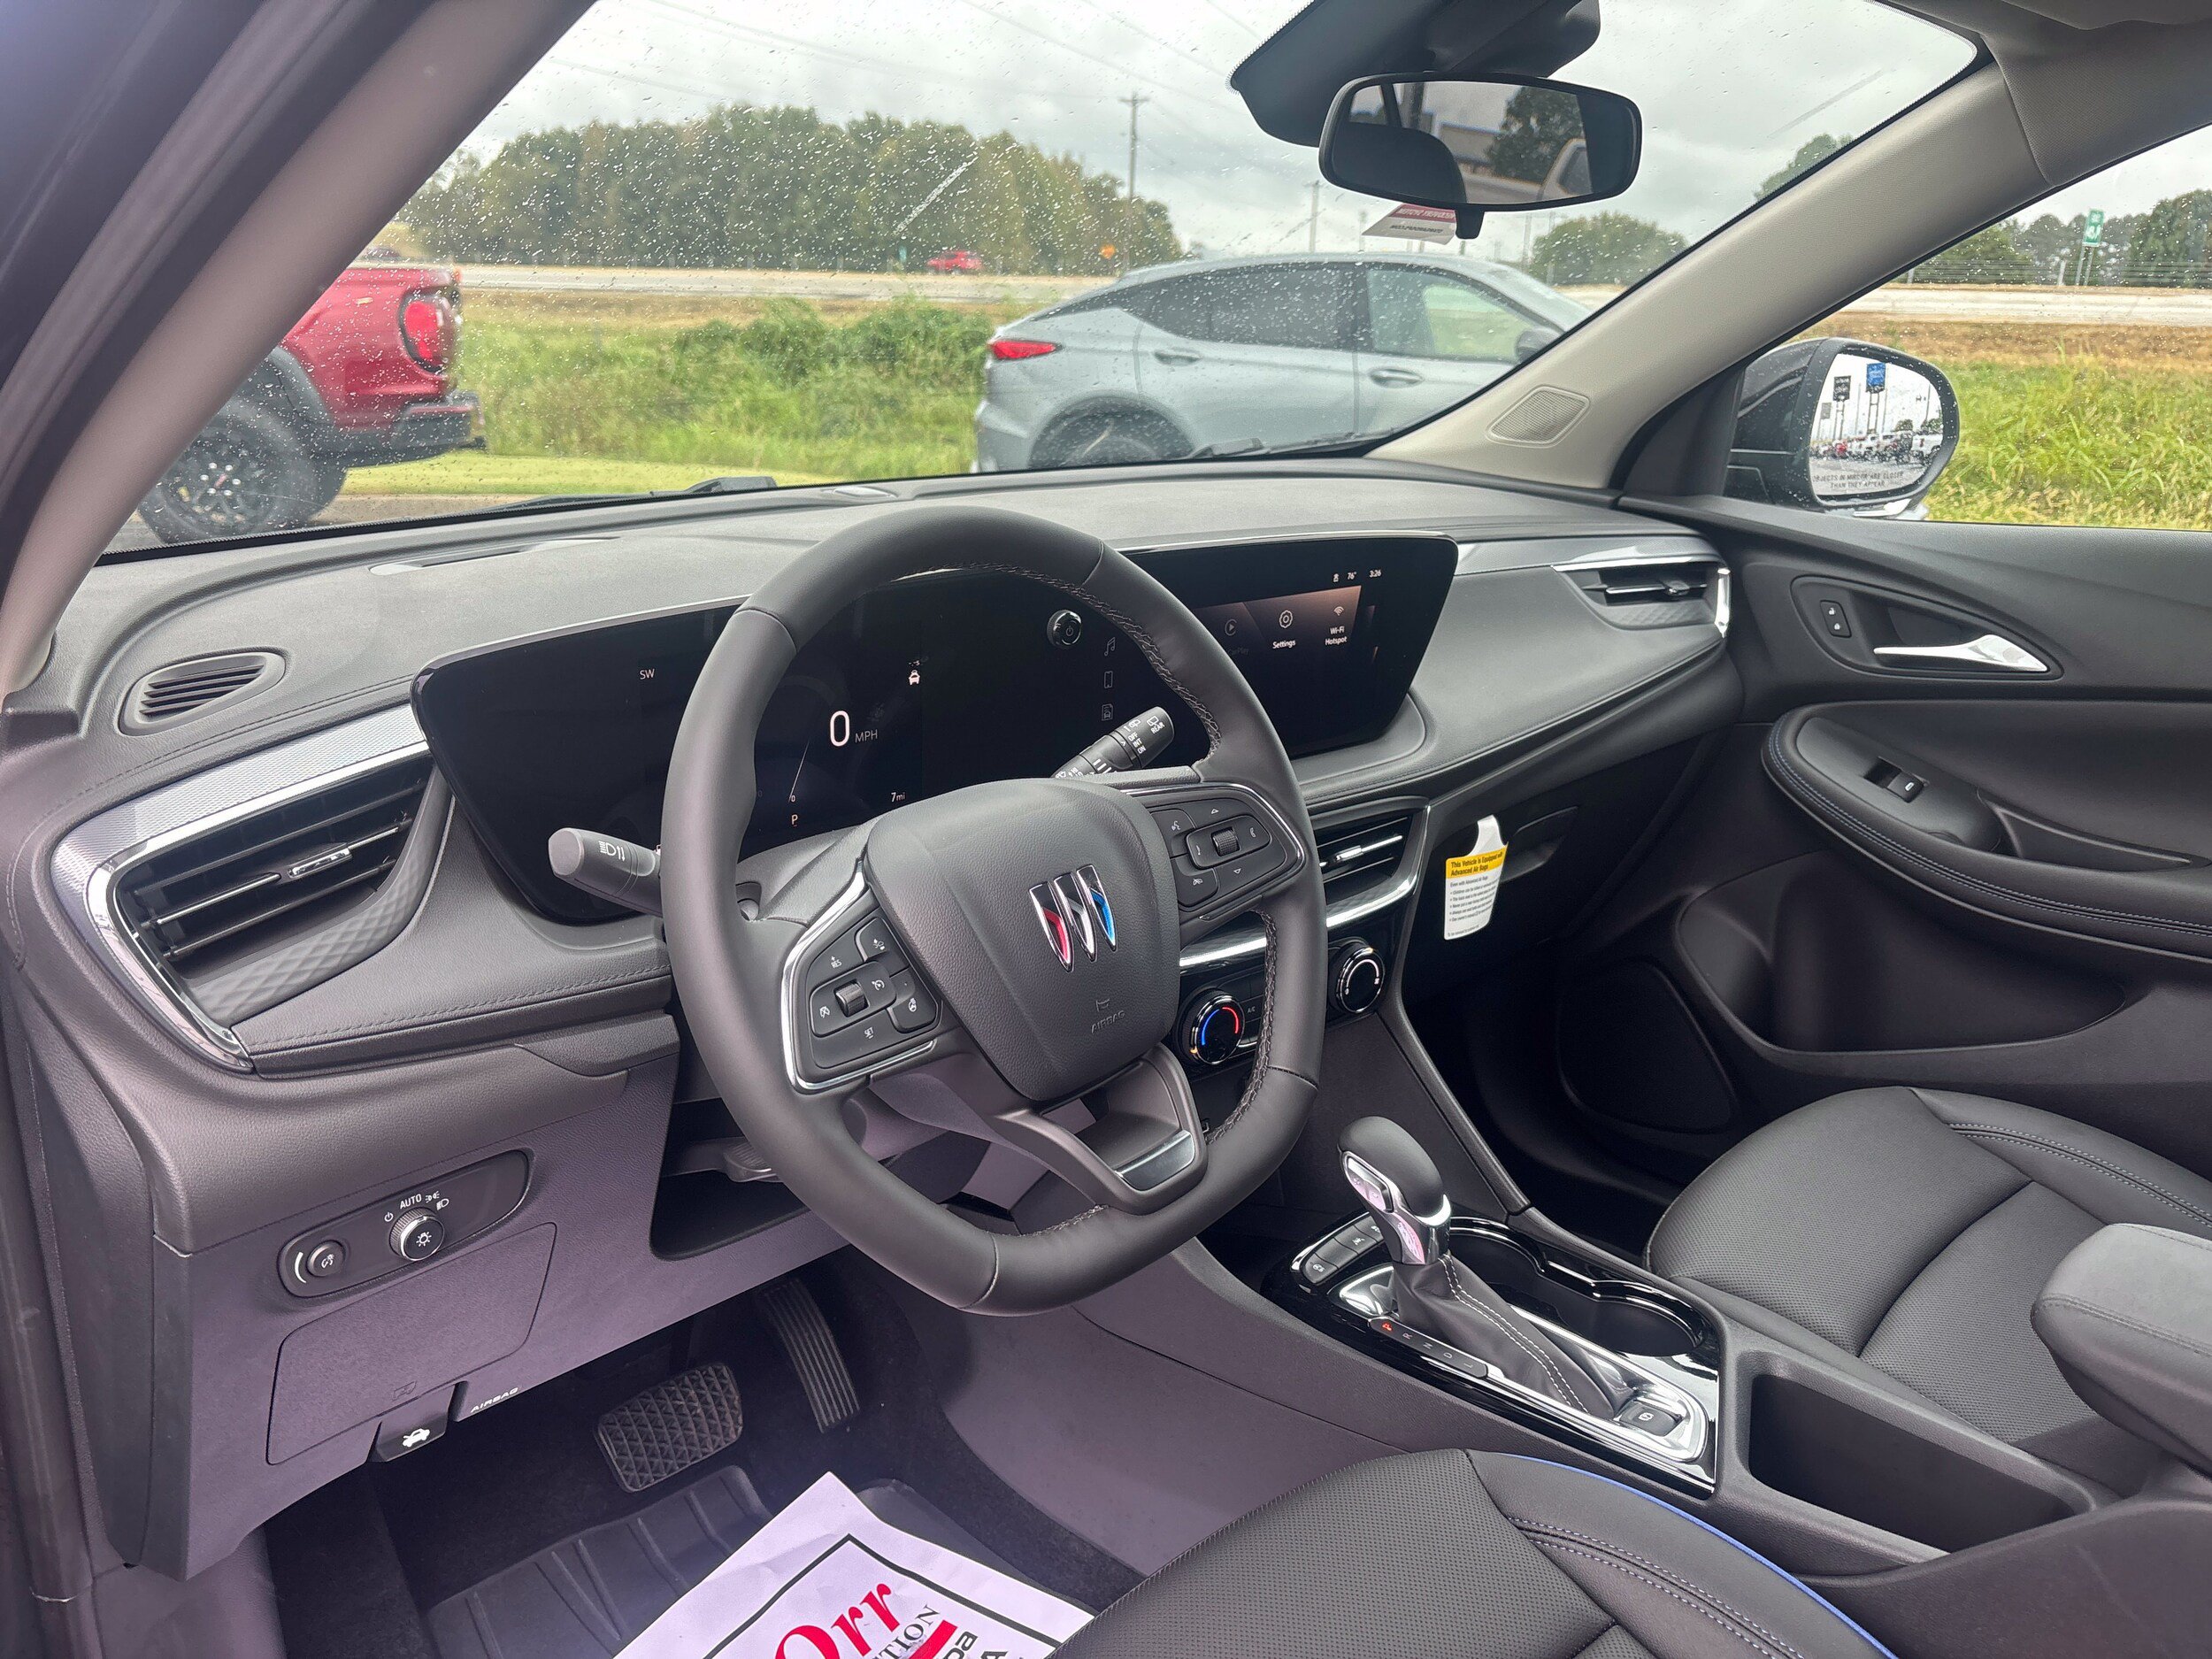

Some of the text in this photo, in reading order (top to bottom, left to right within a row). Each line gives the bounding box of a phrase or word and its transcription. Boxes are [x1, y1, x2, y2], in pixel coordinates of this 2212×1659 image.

[1330, 626, 1345, 634] Wi-Fi
[1272, 640, 1296, 649] Settings
[1325, 636, 1348, 646] Hotspot
[640, 668, 655, 680] SW
[830, 710, 878, 747] 0 MPH
[1150, 721, 1165, 734] REAR
[1128, 732, 1139, 741] OFF
[1133, 738, 1142, 748] INT
[1137, 745, 1146, 754] ON
[791, 814, 799, 825] P
[1482, 854, 1497, 863] Equipped
[1451, 867, 1472, 876] Advanced
[831, 959, 842, 969] RES
[1091, 1010, 1125, 1033] AIRBAG
[864, 1026, 874, 1038] SET
[400, 1193, 422, 1210] AUTO
[471, 1387, 518, 1413] AIRBAG
[872, 1604, 940, 1659] TION
